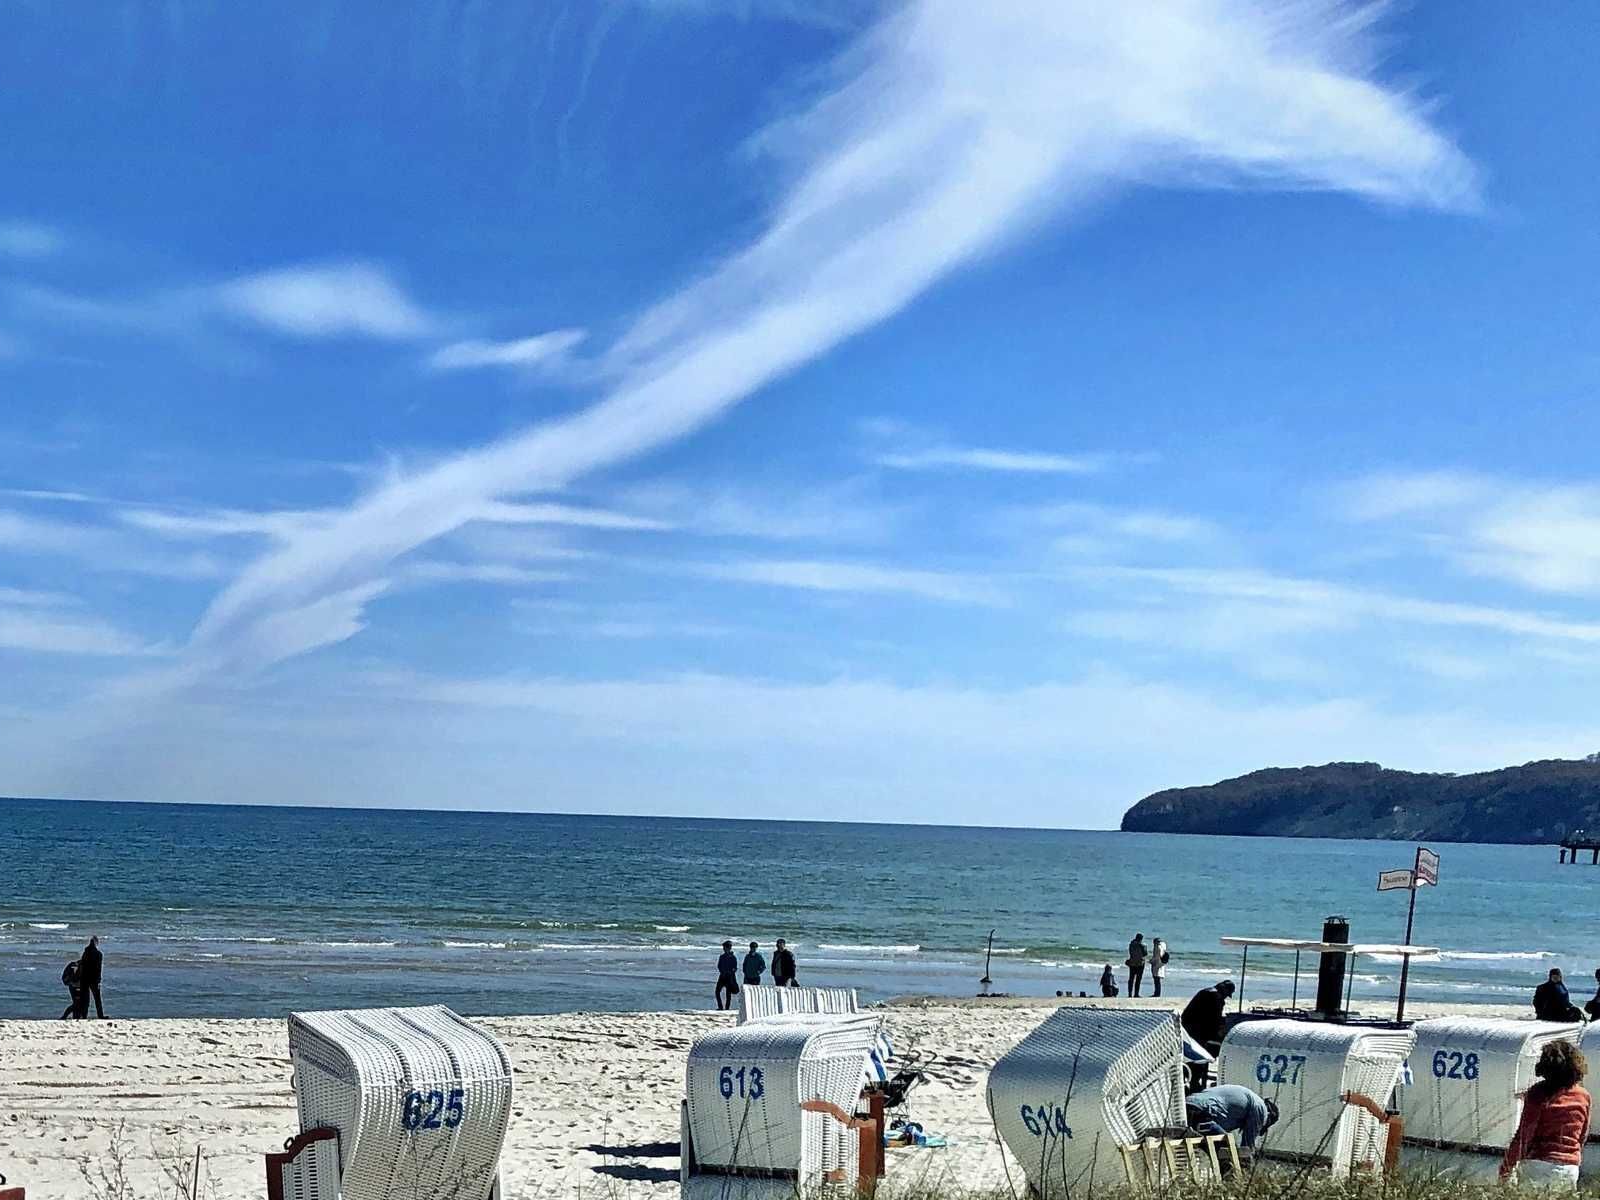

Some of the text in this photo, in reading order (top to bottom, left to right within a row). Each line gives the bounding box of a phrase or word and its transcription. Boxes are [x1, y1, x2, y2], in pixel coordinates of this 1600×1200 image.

[1256, 1054, 1306, 1085] 627
[1432, 1050, 1480, 1080] 628
[719, 1066, 763, 1099] 613
[402, 1089, 464, 1132] 625
[1020, 1104, 1073, 1139] 614
